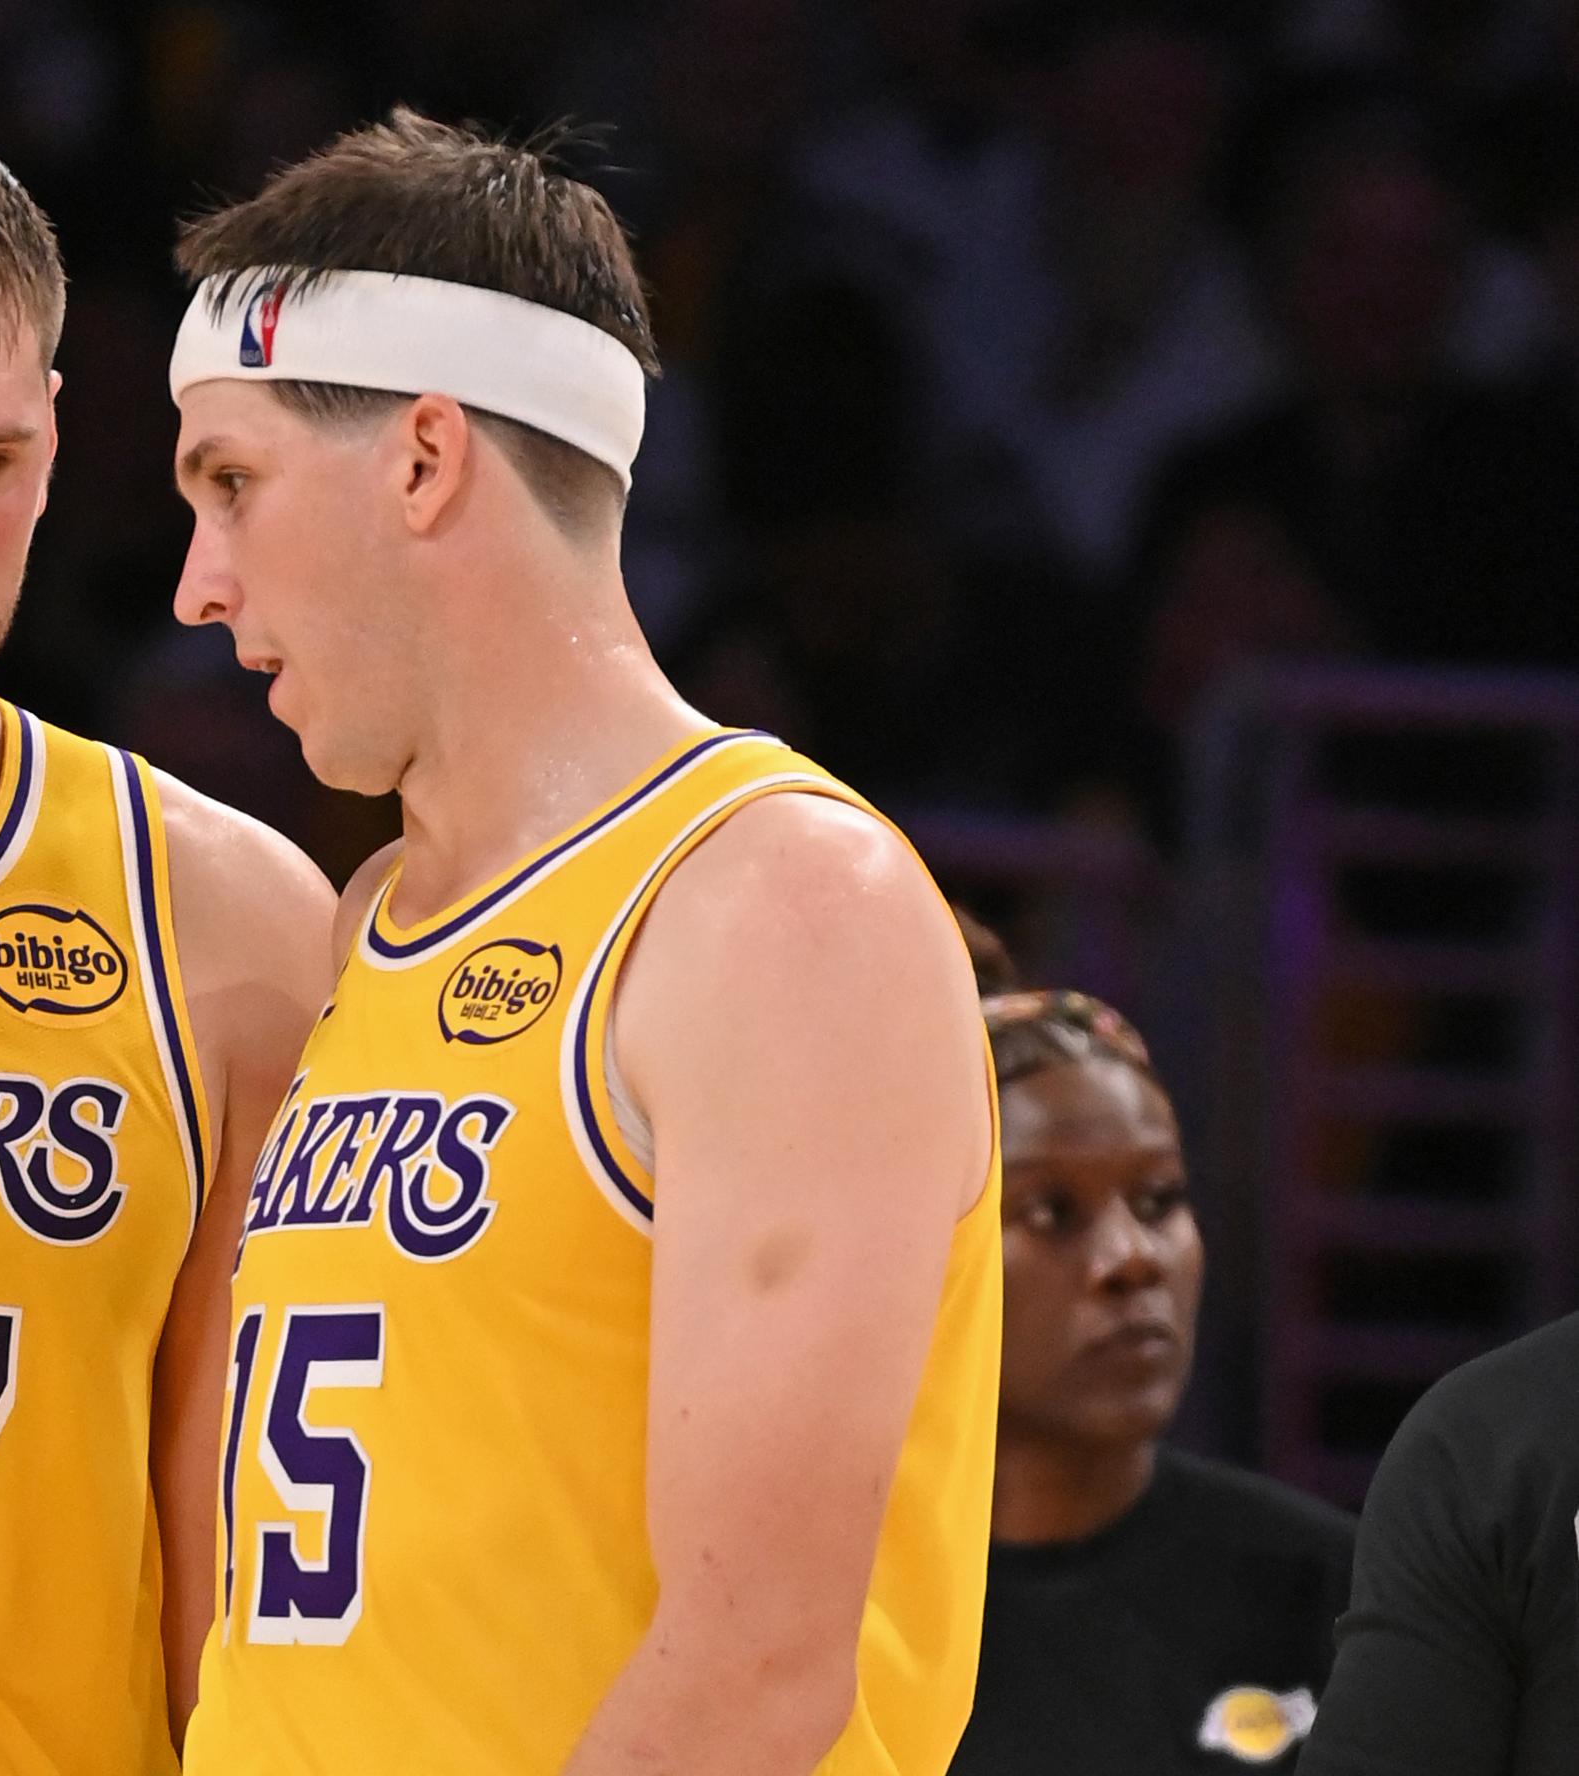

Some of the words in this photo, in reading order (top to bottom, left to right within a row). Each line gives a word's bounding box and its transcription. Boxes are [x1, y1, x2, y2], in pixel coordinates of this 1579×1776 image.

[16, 971, 71, 991] 비비고
[452, 964, 551, 1015] bibigo
[460, 1003, 501, 1021] 비비고
[232, 1068, 518, 1272] AKERS
[218, 1302, 385, 1648] 15
